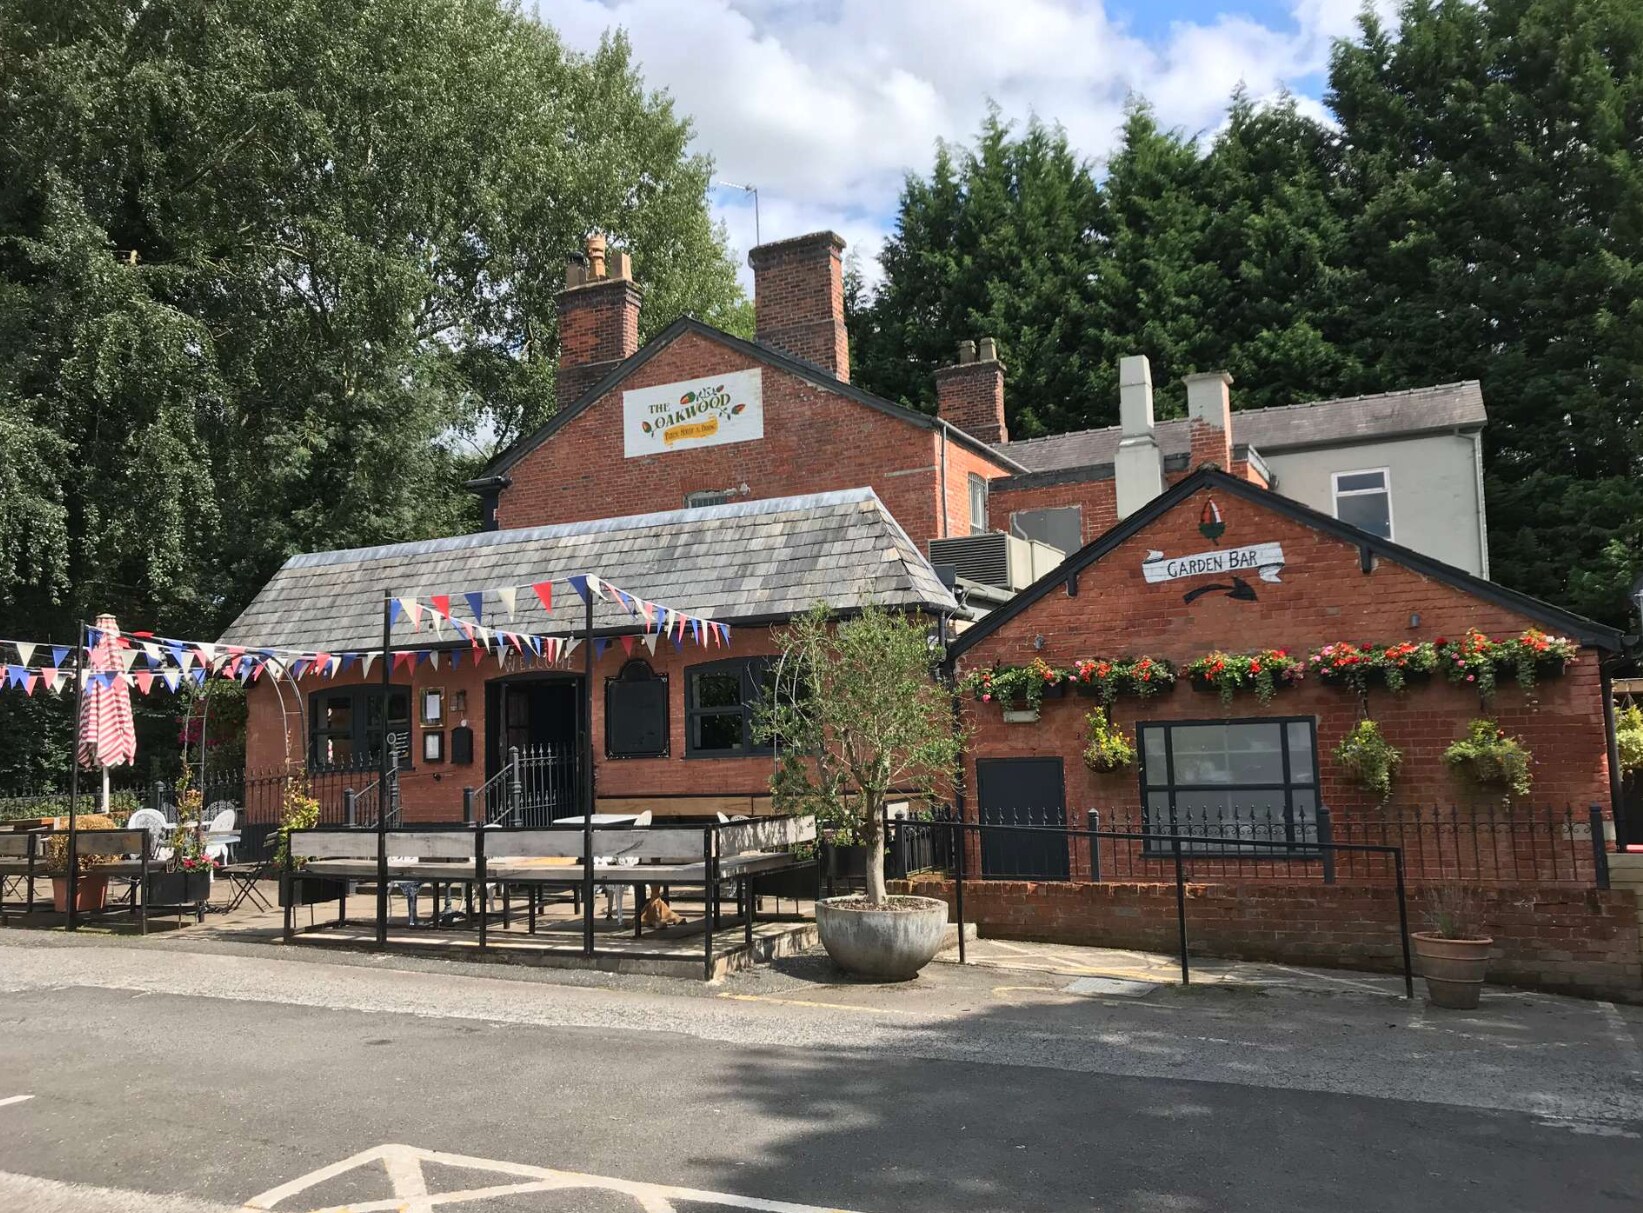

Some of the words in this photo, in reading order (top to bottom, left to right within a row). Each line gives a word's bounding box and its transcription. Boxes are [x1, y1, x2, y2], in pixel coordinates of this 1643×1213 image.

[648, 402, 670, 414] THE
[655, 393, 731, 429] OAKWOOD
[1167, 555, 1222, 578] GARDEN
[1229, 551, 1258, 568] BAR
